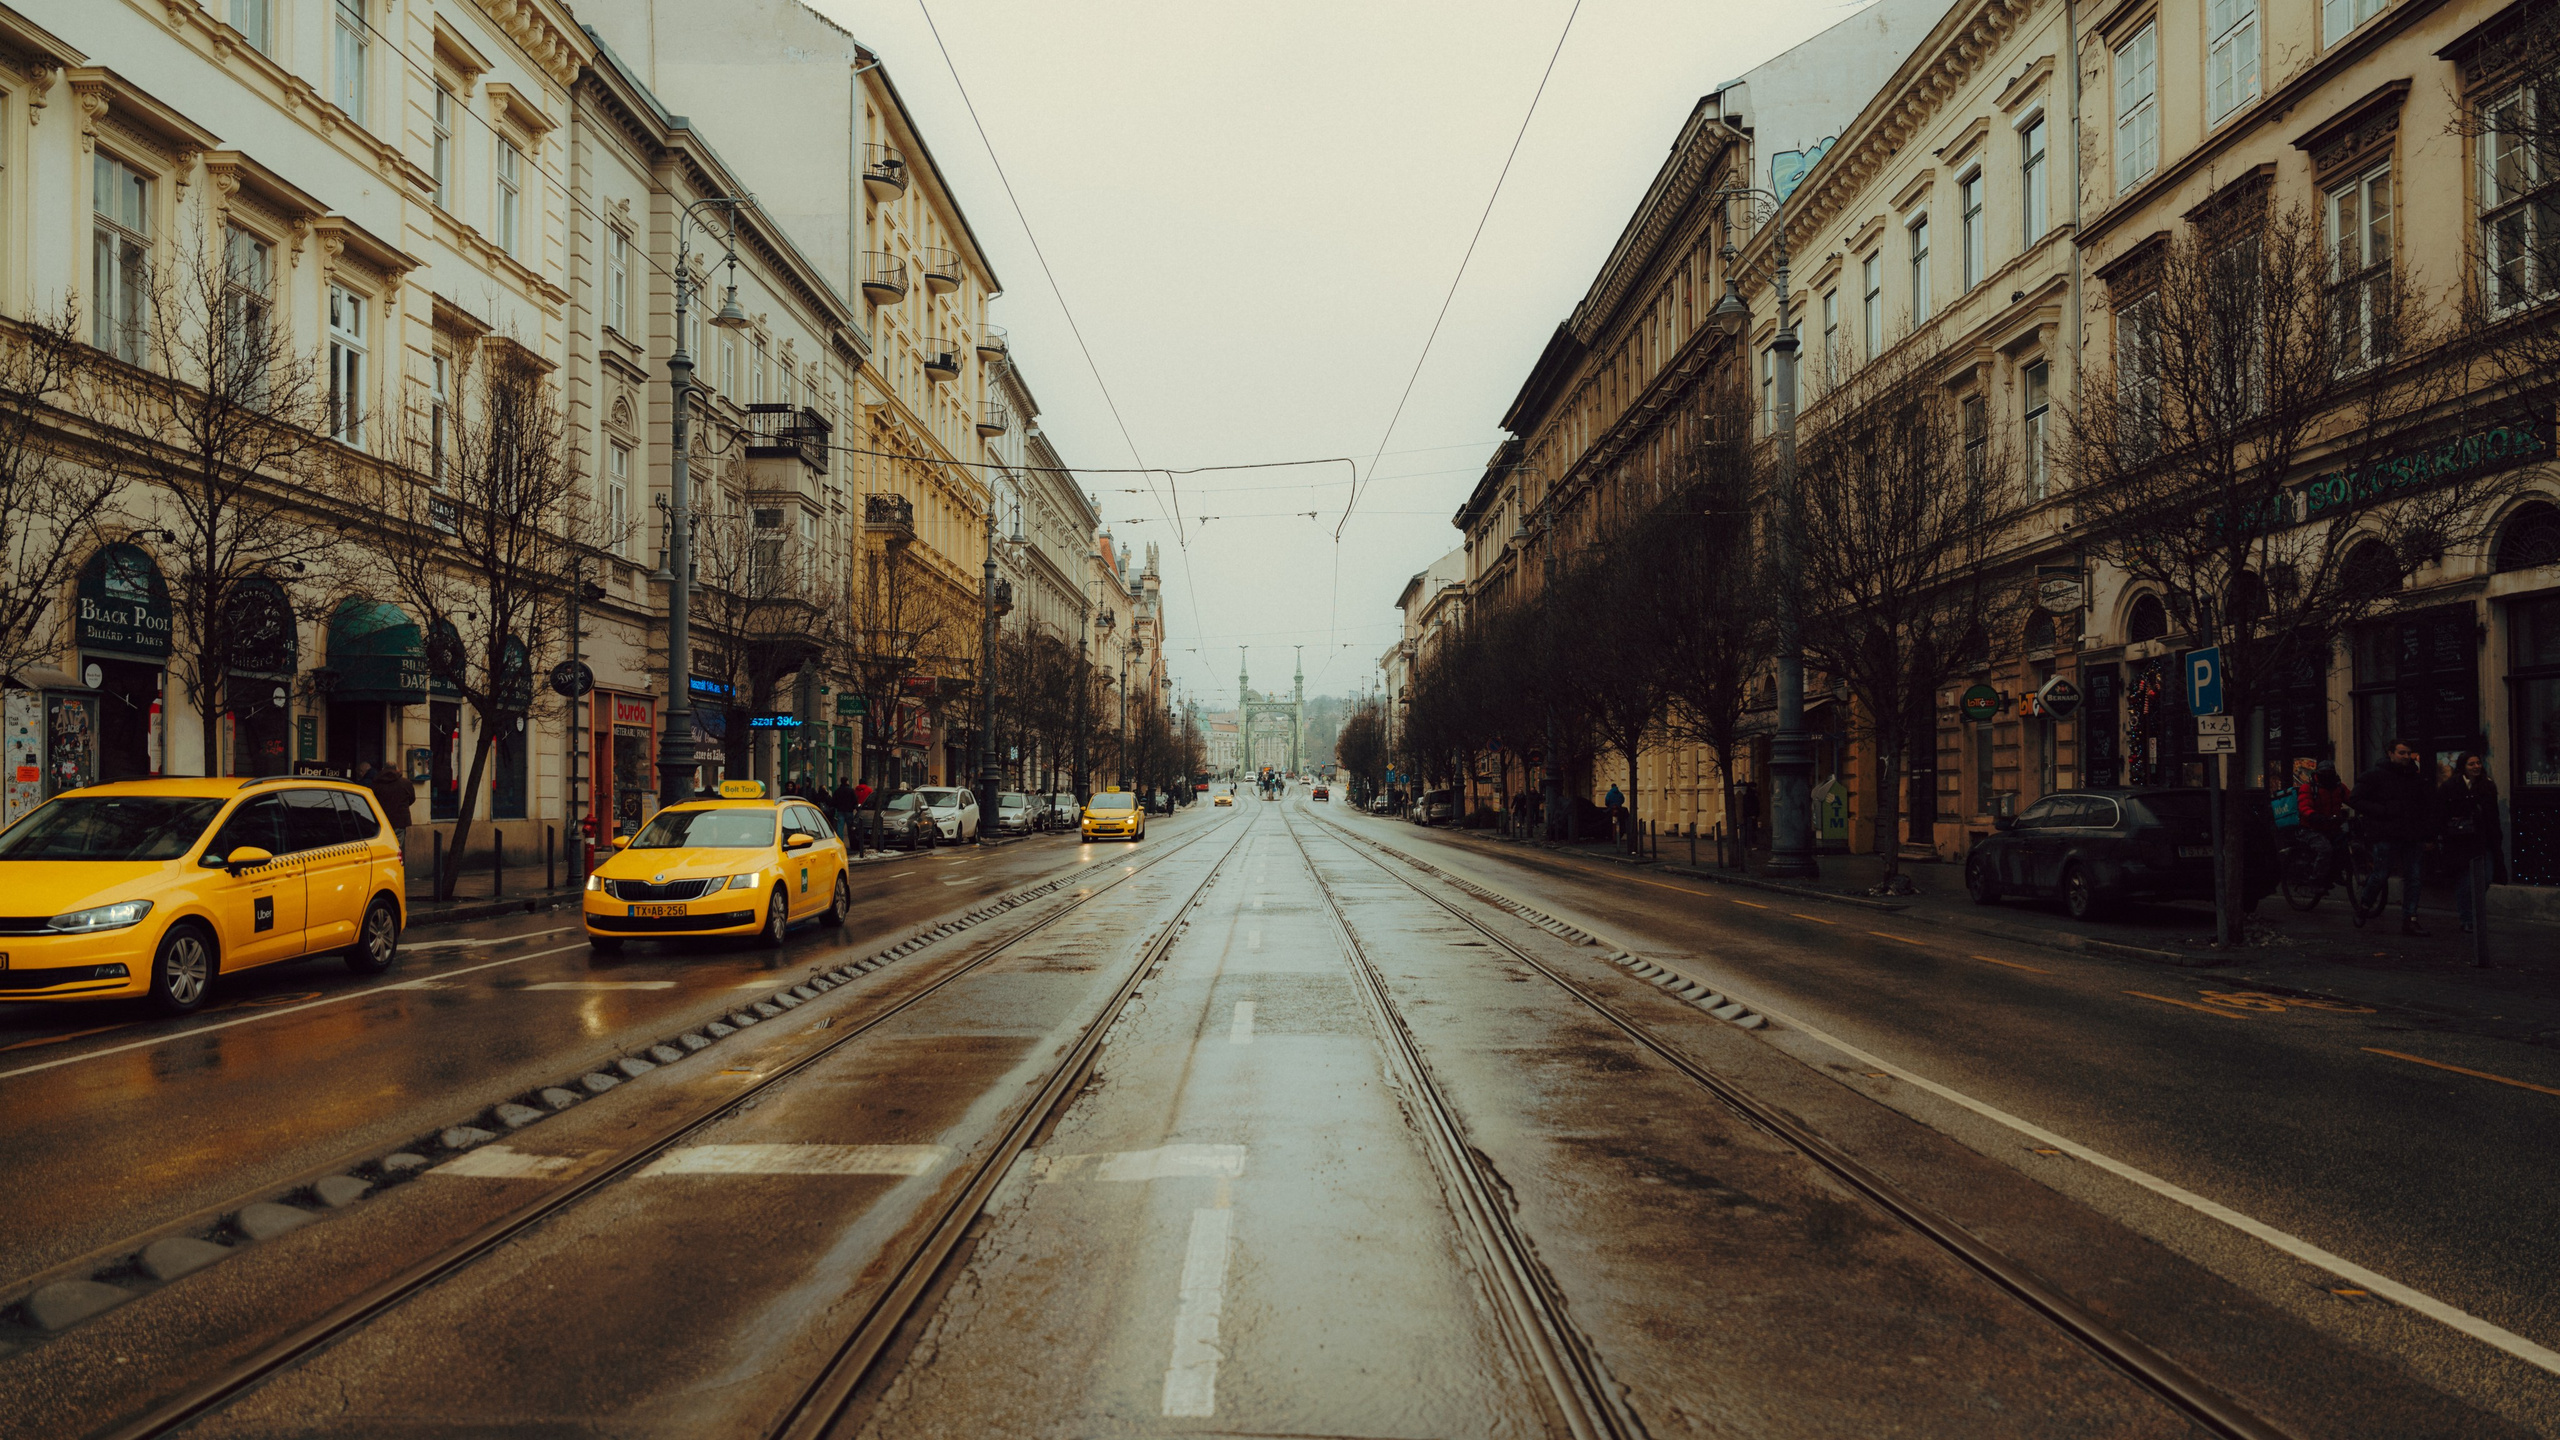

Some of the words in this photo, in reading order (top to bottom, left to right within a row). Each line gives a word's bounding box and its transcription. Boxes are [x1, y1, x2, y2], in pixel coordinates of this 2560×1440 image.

[2193, 659, 2212, 708] P
[2047, 694, 2079, 702] BERNARD
[617, 696, 646, 722] burda
[299, 767, 322, 776] Uber
[324, 768, 340, 777] Taxi
[724, 785, 740, 793] Bolt
[741, 785, 757, 793] Taxi
[257, 909, 272, 920] Uber
